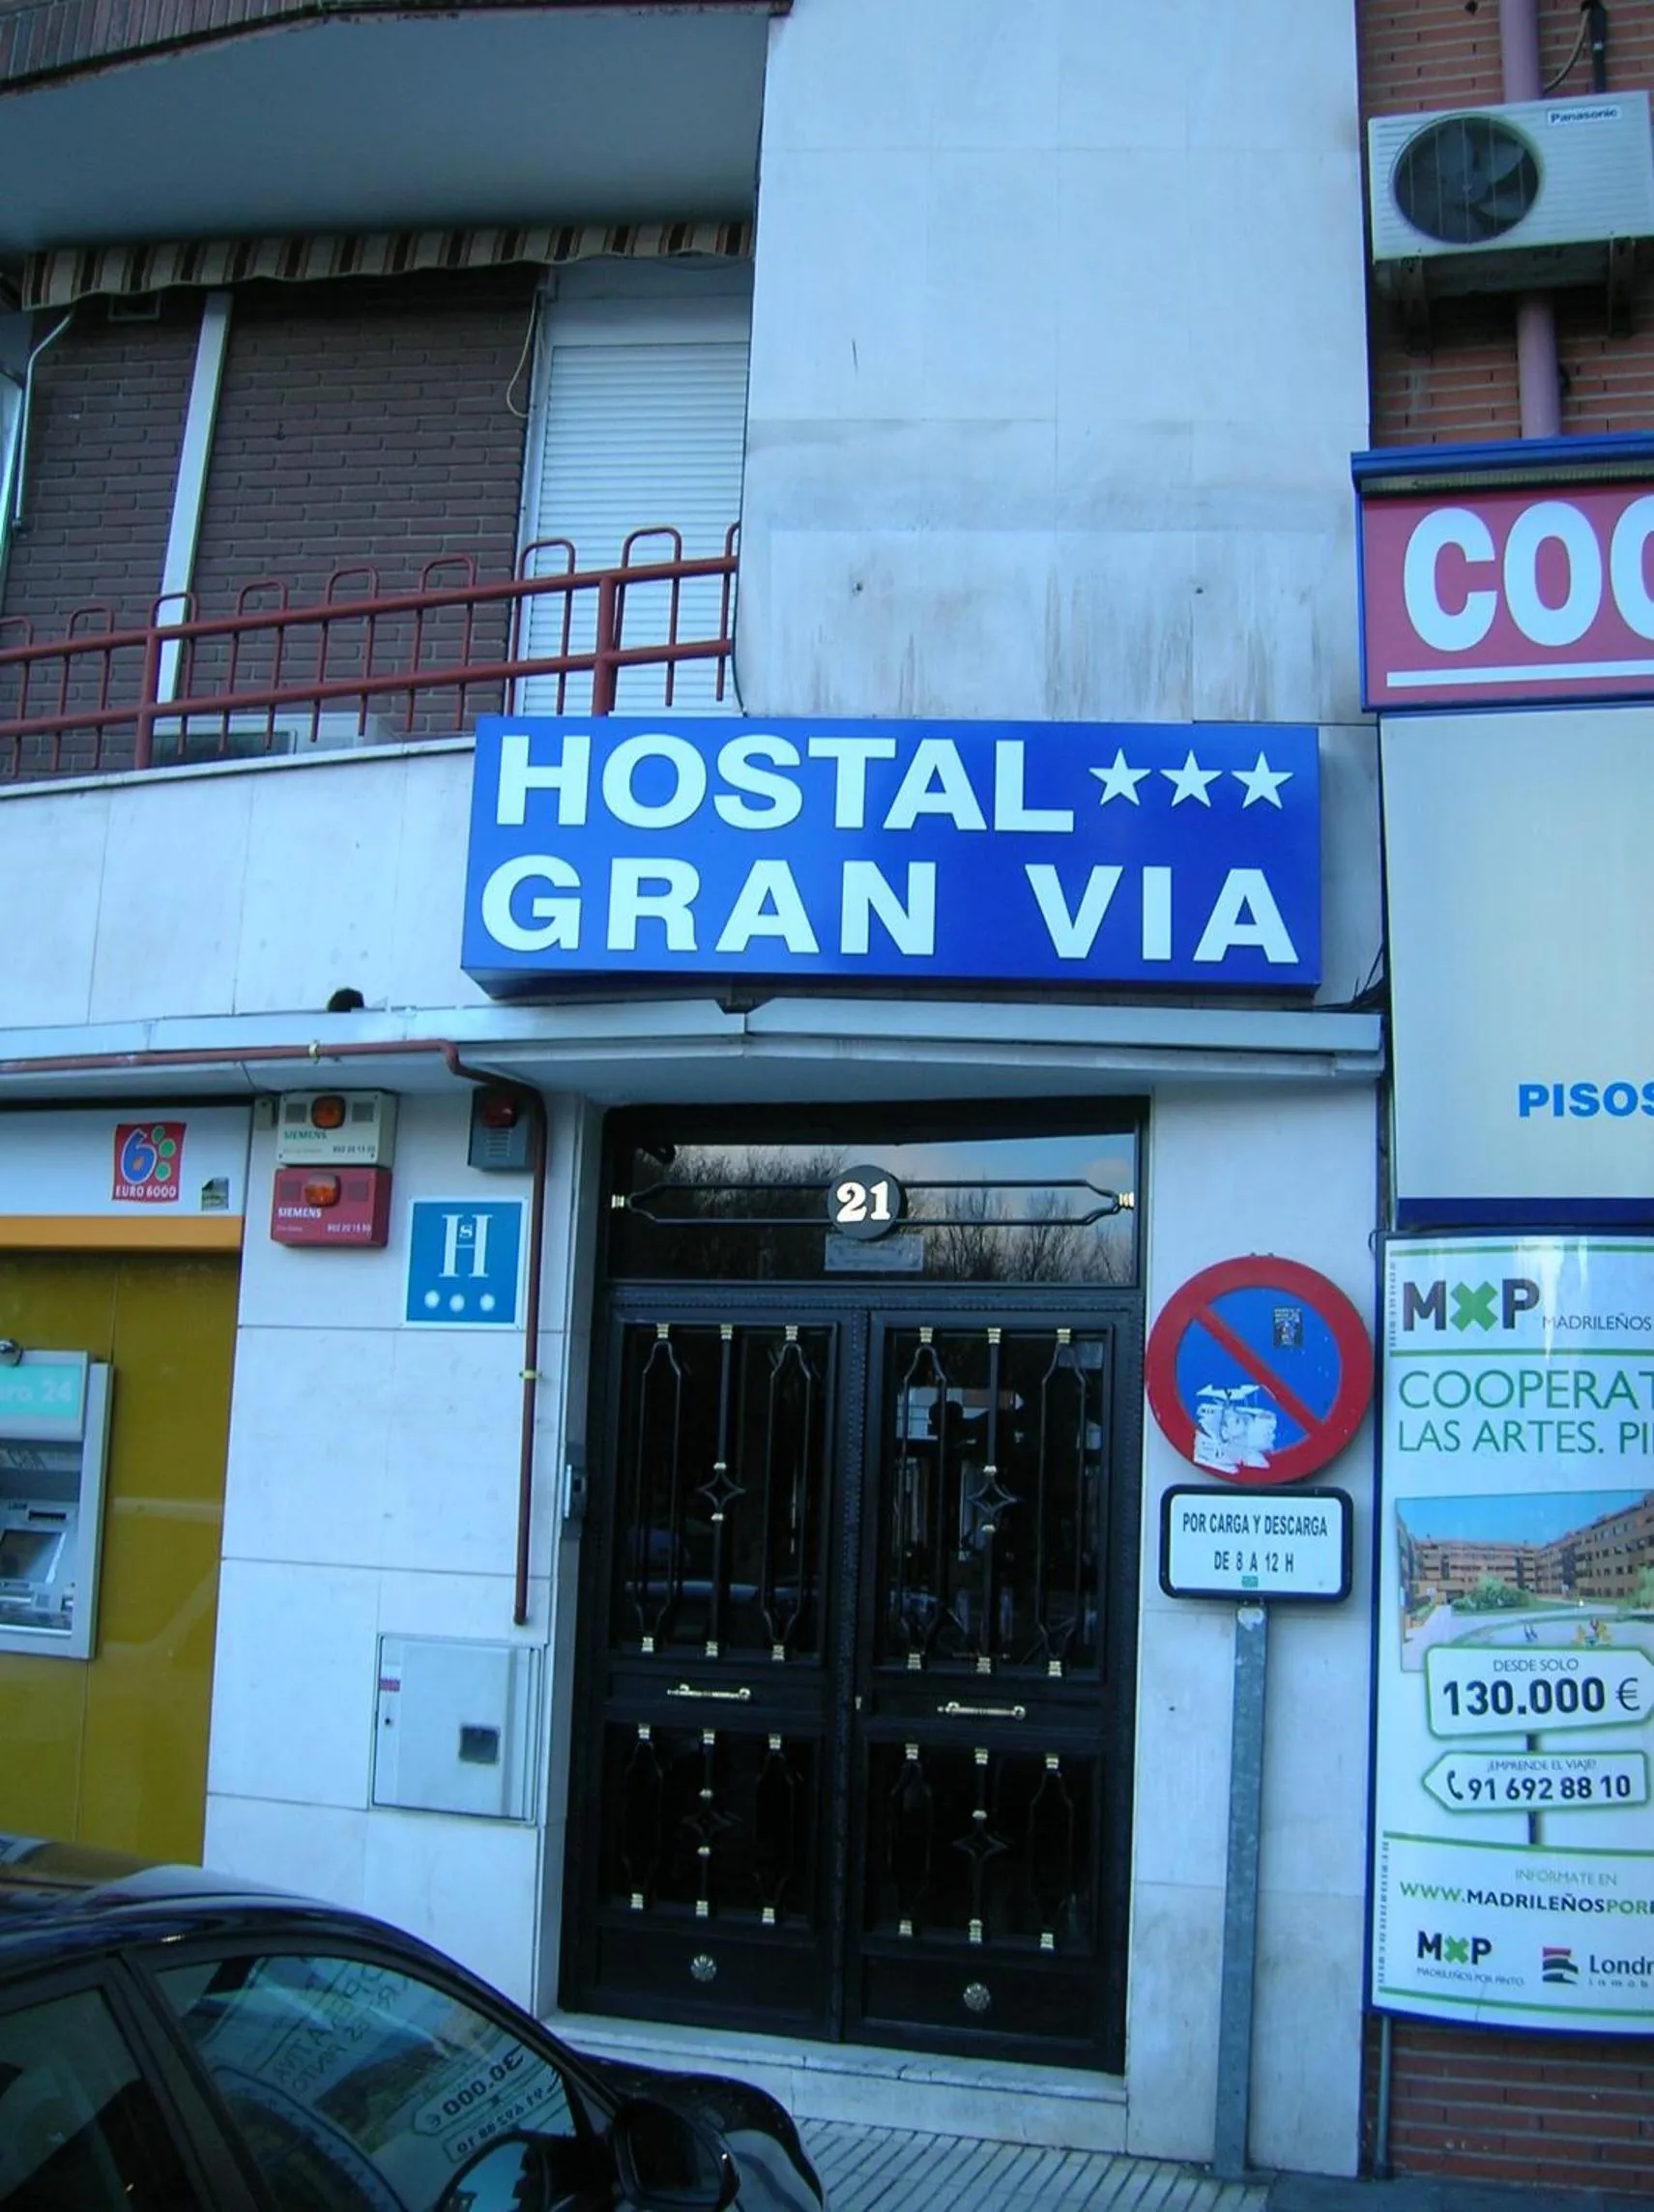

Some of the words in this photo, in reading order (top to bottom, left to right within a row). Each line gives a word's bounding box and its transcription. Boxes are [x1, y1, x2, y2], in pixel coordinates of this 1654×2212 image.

[1550, 108, 1618, 123] Panasonic
[497, 734, 1074, 833] HOSTAL
[481, 854, 937, 955] GRAN
[1025, 863, 1299, 965] VIA
[283, 1129, 327, 1140] SIEMENS
[115, 1184, 144, 1197] EURO
[146, 1184, 177, 1198] 6000
[836, 1180, 891, 1223] 21
[277, 1207, 322, 1218] SIEMENS
[1542, 1312, 1652, 1331] MADRILEÑOS
[42, 1379, 71, 1403] 24
[1399, 1420, 1461, 1452] LAS
[1472, 1420, 1604, 1454] ARTES.
[1619, 1422, 1654, 1454] PI
[1182, 1512, 1206, 1533] POR
[1209, 1513, 1250, 1534] CARGA
[1253, 1515, 1262, 1533] Y
[1264, 1515, 1328, 1536] DESCARGA
[1214, 1551, 1230, 1571] DE
[1235, 1551, 1243, 1571] 8
[1249, 1552, 1258, 1572] A
[1265, 1553, 1278, 1573] 12
[1285, 1554, 1294, 1573] H
[1493, 1659, 1538, 1673] DESDE
[1540, 1658, 1579, 1672] SOLO
[1443, 1676, 1605, 1716] 130.000
[1615, 1677, 1640, 1711] €
[1467, 1777, 1495, 1801] 91
[1505, 1776, 1553, 1801] 692
[1560, 1776, 1592, 1799] 88
[1600, 1774, 1631, 1798] 10
[1598, 1873, 1616, 1886] EN
[1400, 1880, 1654, 1914] WWW.MADRILEÑOSPOR
[1588, 1953, 1654, 1975] Londr
